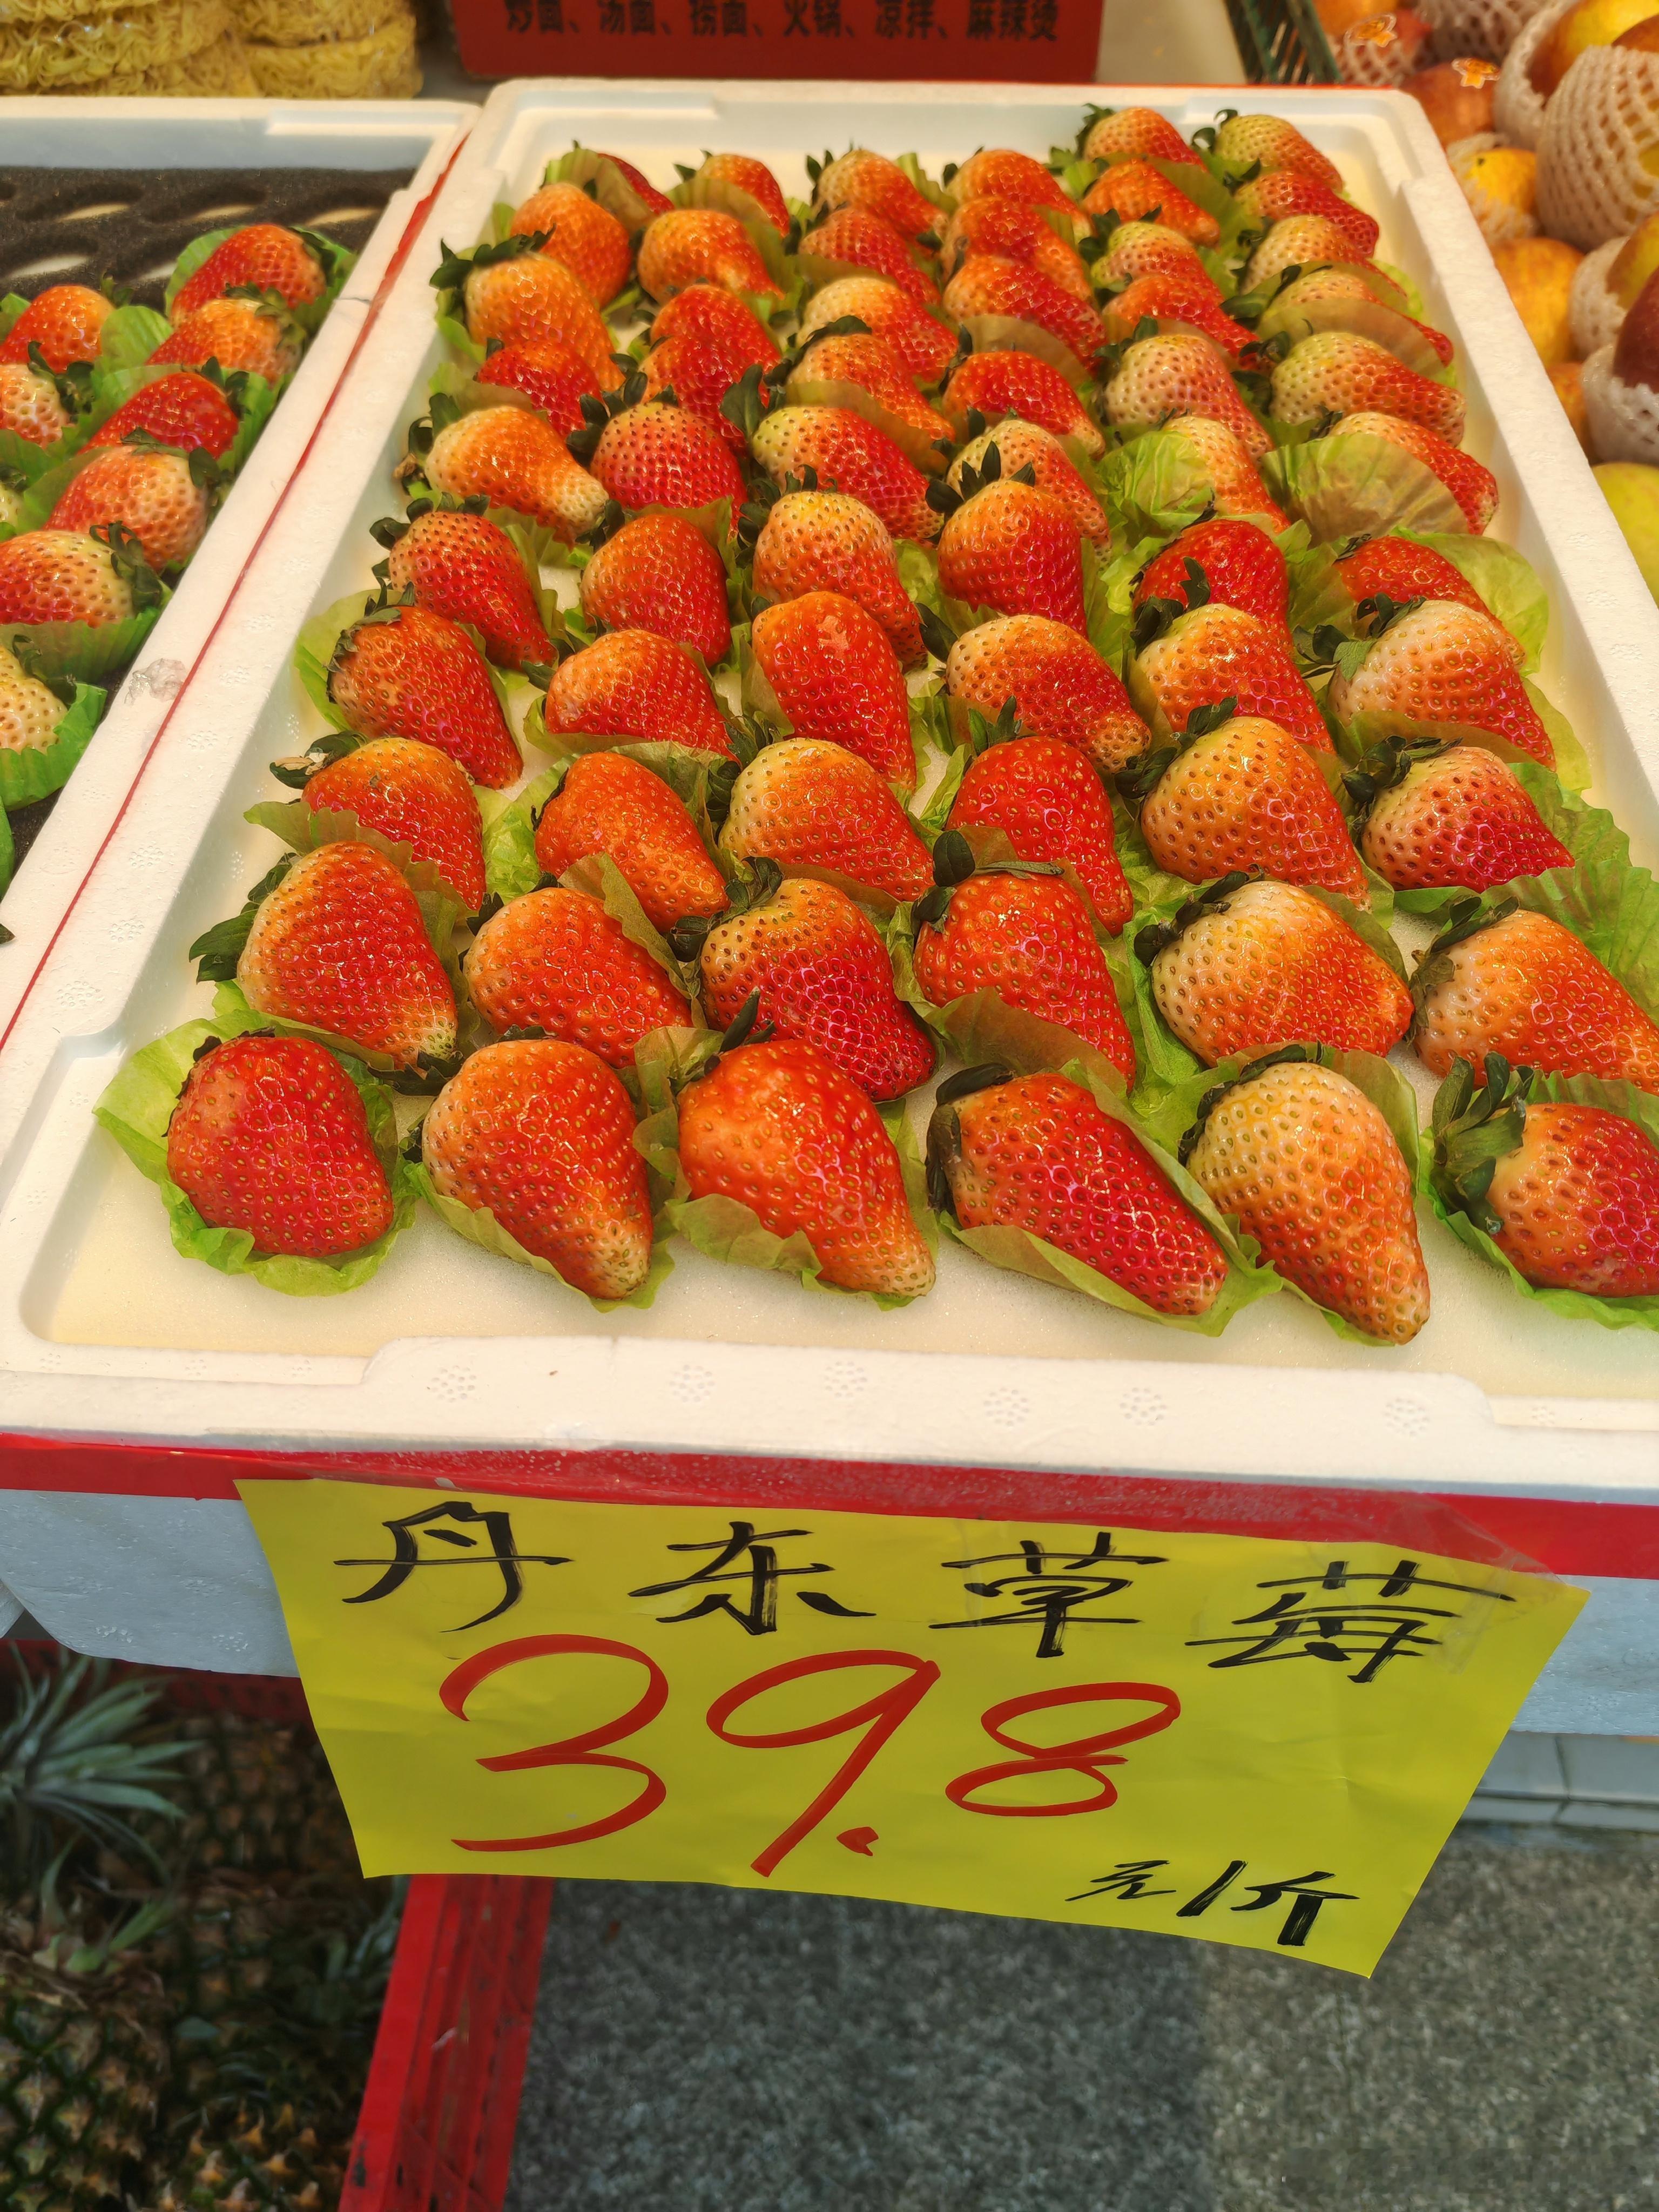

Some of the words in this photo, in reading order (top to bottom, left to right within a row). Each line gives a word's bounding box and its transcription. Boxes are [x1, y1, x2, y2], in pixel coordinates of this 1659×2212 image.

[333, 1500, 1516, 1684] 丹东草莓
[438, 1633, 1182, 1878] 39.8
